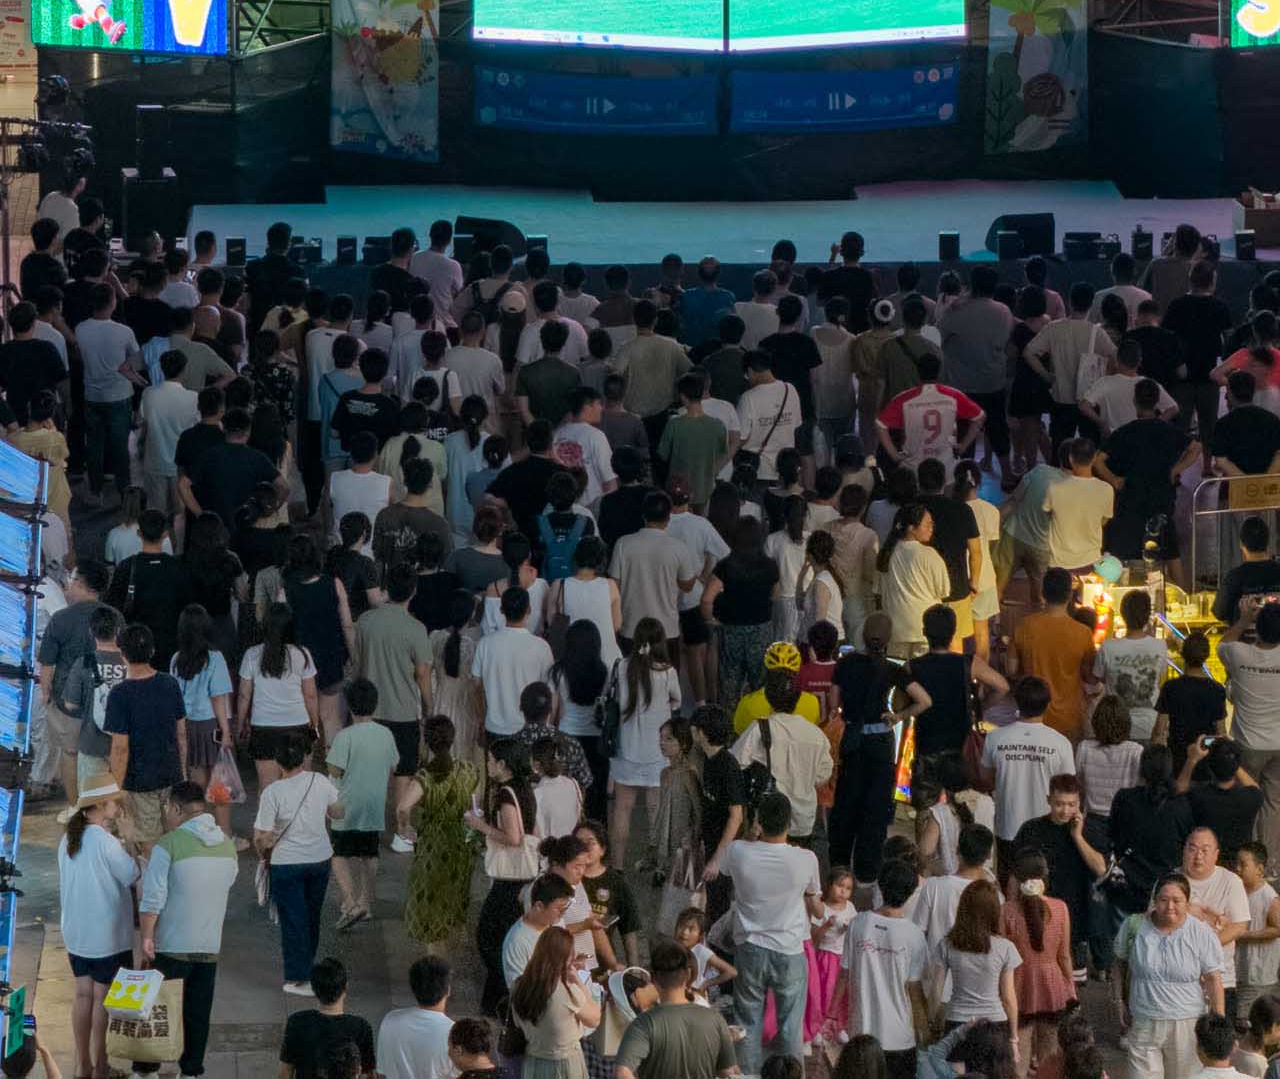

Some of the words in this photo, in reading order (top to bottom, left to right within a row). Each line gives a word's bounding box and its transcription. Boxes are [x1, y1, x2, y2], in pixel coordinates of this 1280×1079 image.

[922, 409, 942, 444] 9
[997, 744, 1036, 752] MAINTAIN
[1038, 746, 1056, 755] SELF
[1005, 754, 1046, 763] DISCIPLINE
